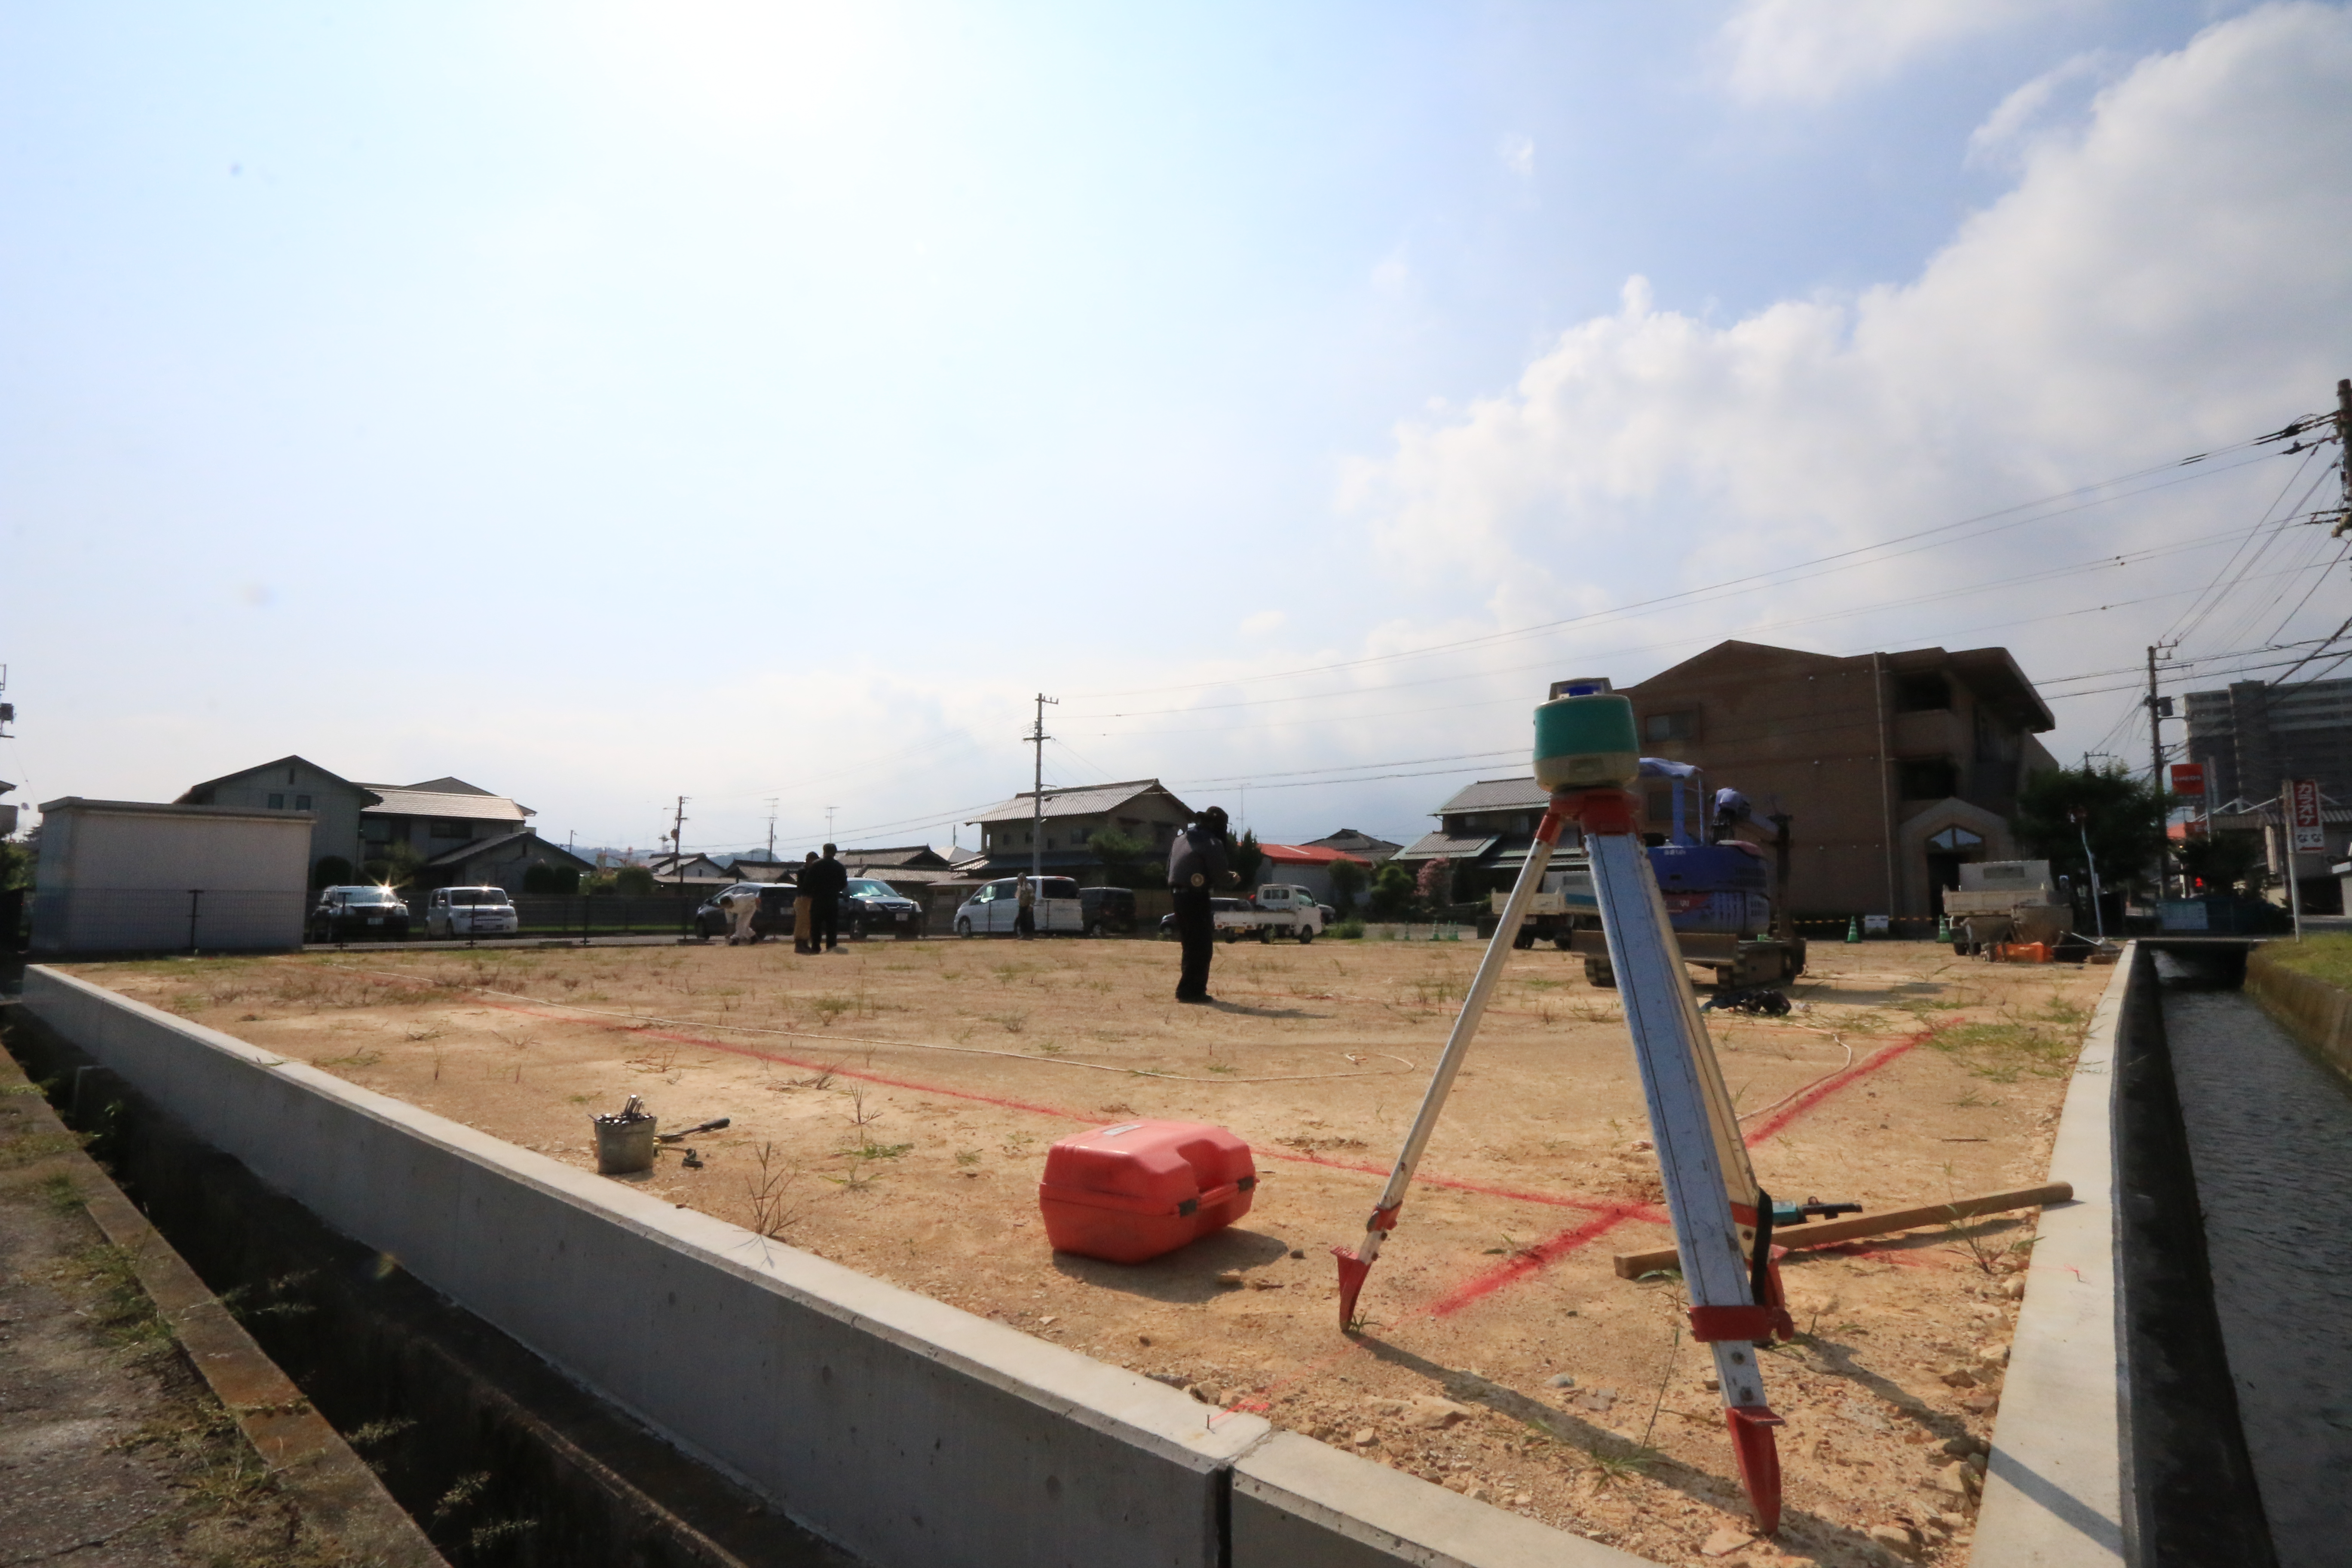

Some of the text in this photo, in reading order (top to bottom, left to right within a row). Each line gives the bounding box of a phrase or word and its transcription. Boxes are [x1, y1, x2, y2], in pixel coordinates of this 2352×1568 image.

[2297, 783, 2315, 824] カラオケ
[2297, 833, 2322, 843] なな
